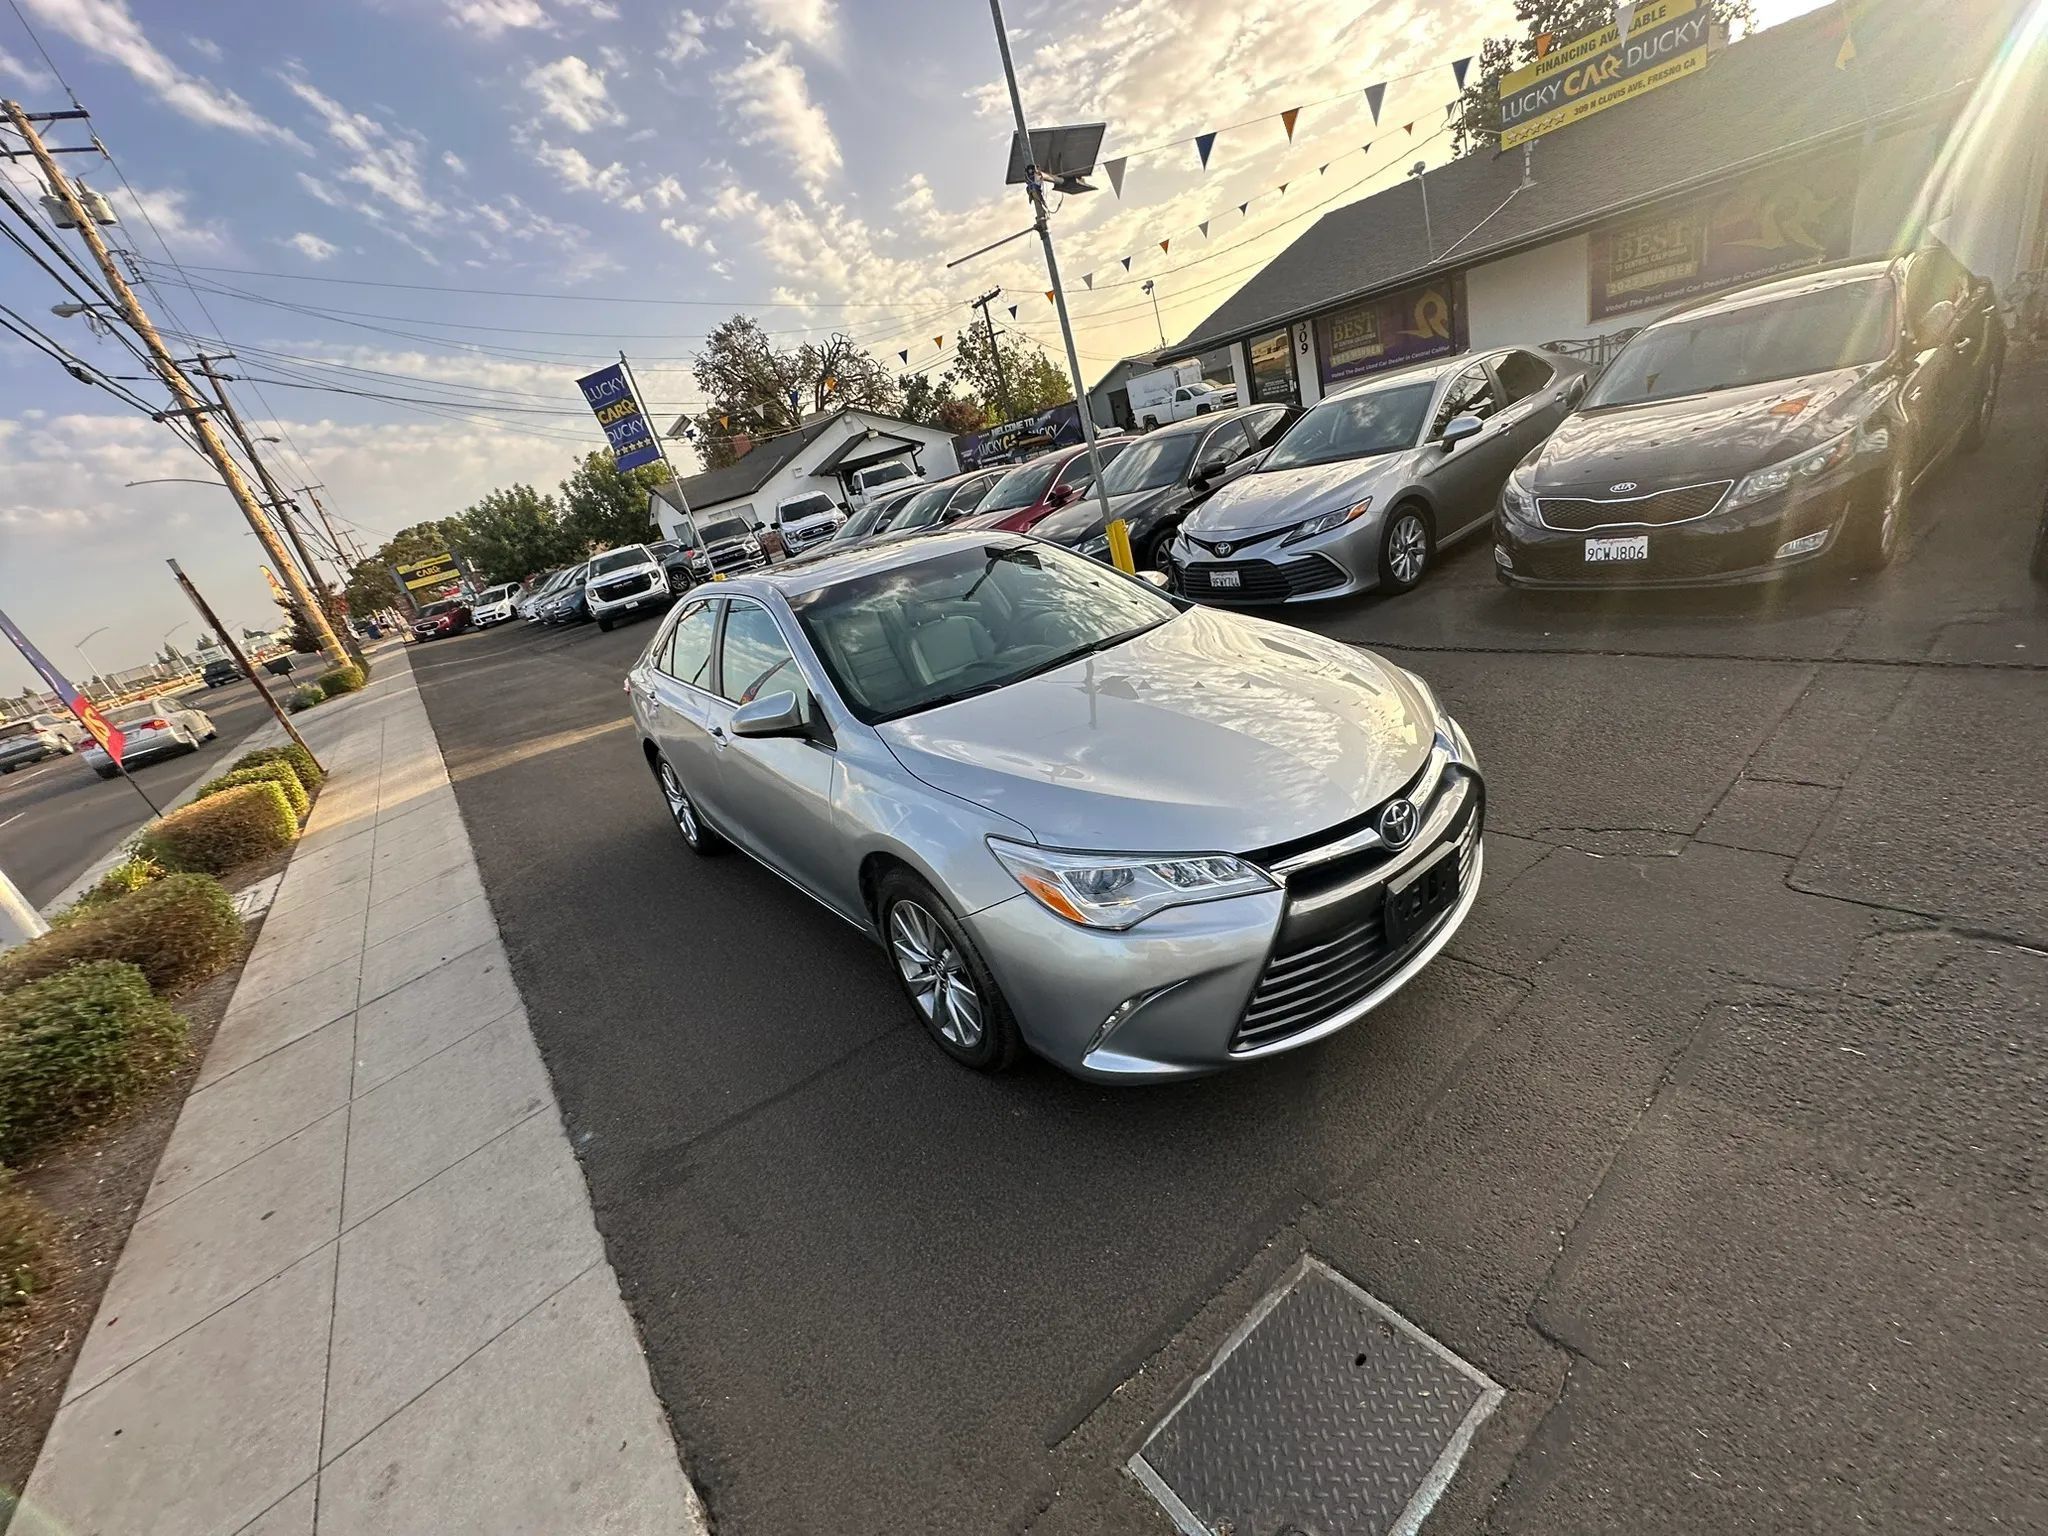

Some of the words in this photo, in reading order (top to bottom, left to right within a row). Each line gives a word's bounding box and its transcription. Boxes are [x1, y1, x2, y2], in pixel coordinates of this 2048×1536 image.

[1502, 80, 1561, 123] LUCKY
[1627, 15, 1705, 68] DUCKY
[1536, 39, 1596, 76] FINANCING
[1573, 103, 1589, 116] 309
[1598, 88, 1626, 106] CLOVIS
[1648, 65, 1681, 85] FRESNO
[1333, 311, 1375, 341] BEST
[584, 375, 625, 402] LUCKY
[606, 418, 645, 443] DUCKY
[991, 420, 1024, 437] WELCOME
[1024, 417, 1035, 428] TO
[978, 438, 1002, 457] LUCKY
[1588, 545, 1645, 560] 9CWJ806
